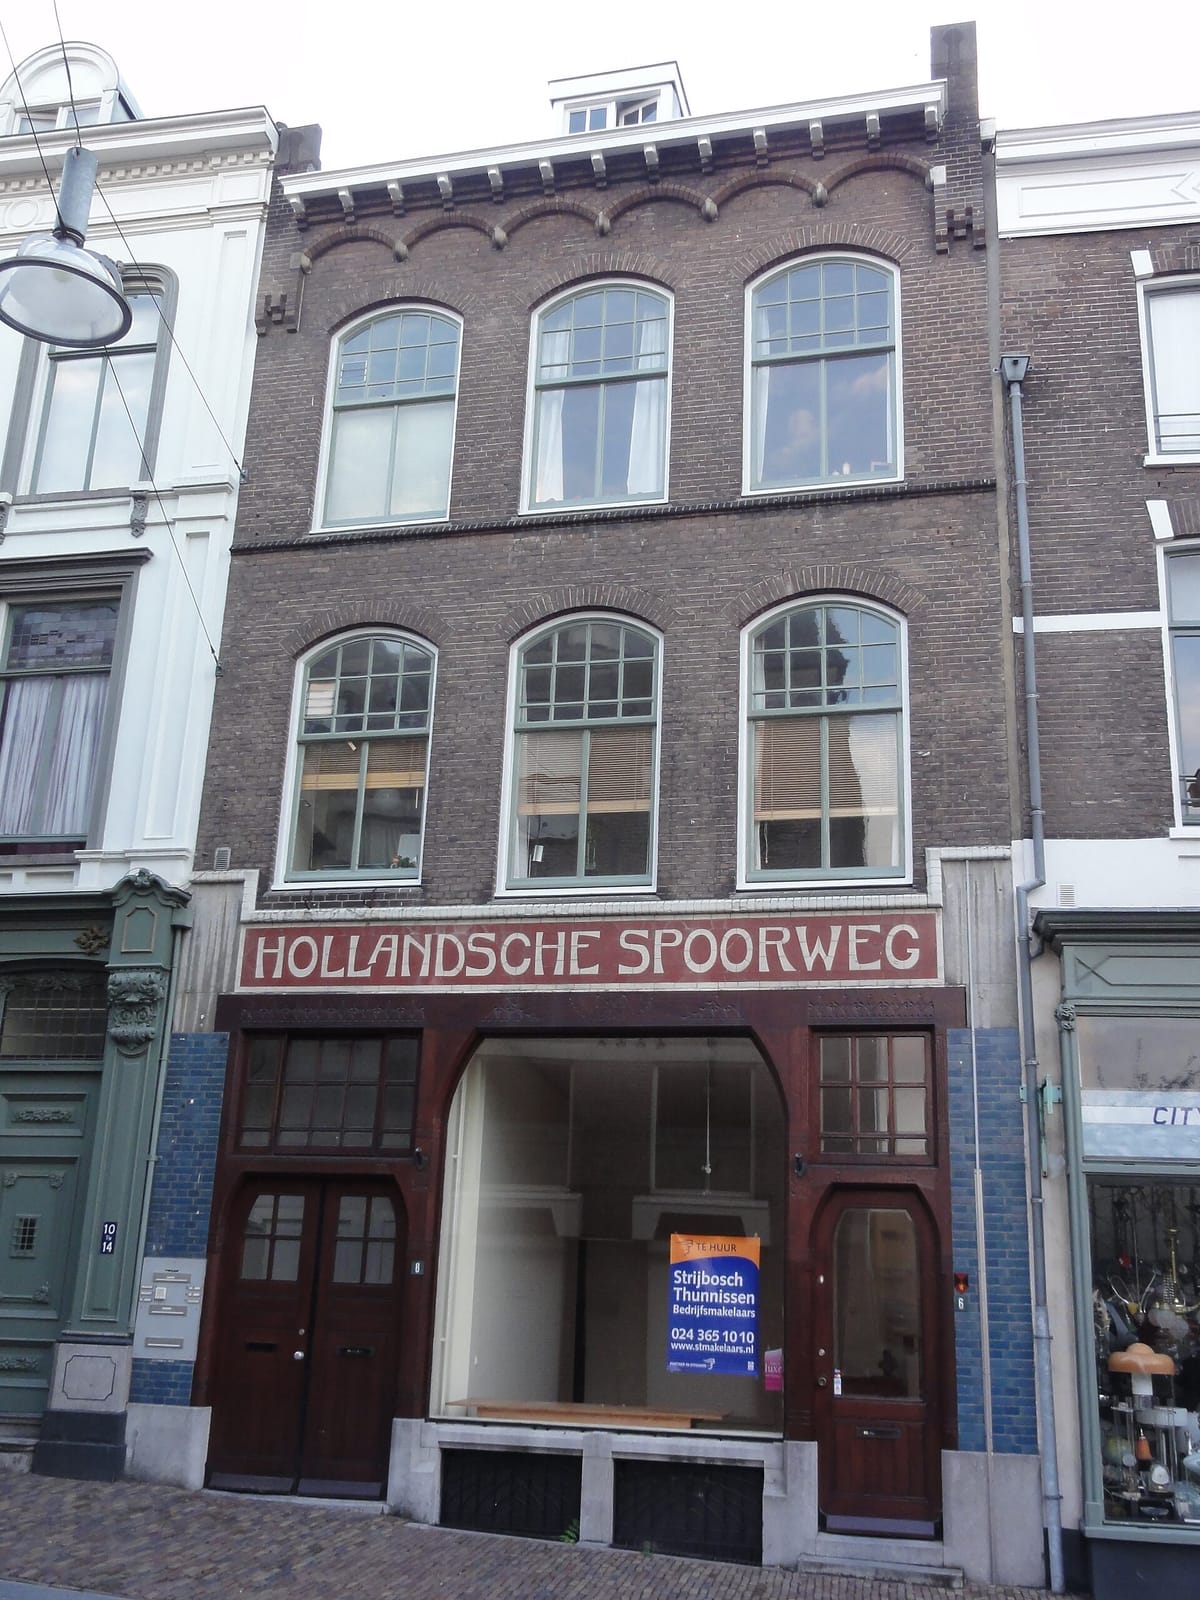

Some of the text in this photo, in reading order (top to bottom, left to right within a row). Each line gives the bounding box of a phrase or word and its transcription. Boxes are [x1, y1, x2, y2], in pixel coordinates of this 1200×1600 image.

[254, 924, 920, 979] HOLLANDSCHE SPOORWEG
[104, 1224, 115, 1235] 10
[102, 1241, 113, 1253] 14
[697, 1243, 737, 1252] TE HUUR
[673, 1270, 743, 1289] Strijbosch
[673, 1286, 755, 1305] Thunnissen
[958, 1297, 964, 1310] 6
[672, 1303, 756, 1319] Bedrijfsmakelaars
[671, 1327, 694, 1341] 024
[697, 1329, 720, 1342] 365
[670, 1342, 754, 1354] www.stmakelaars.nl
